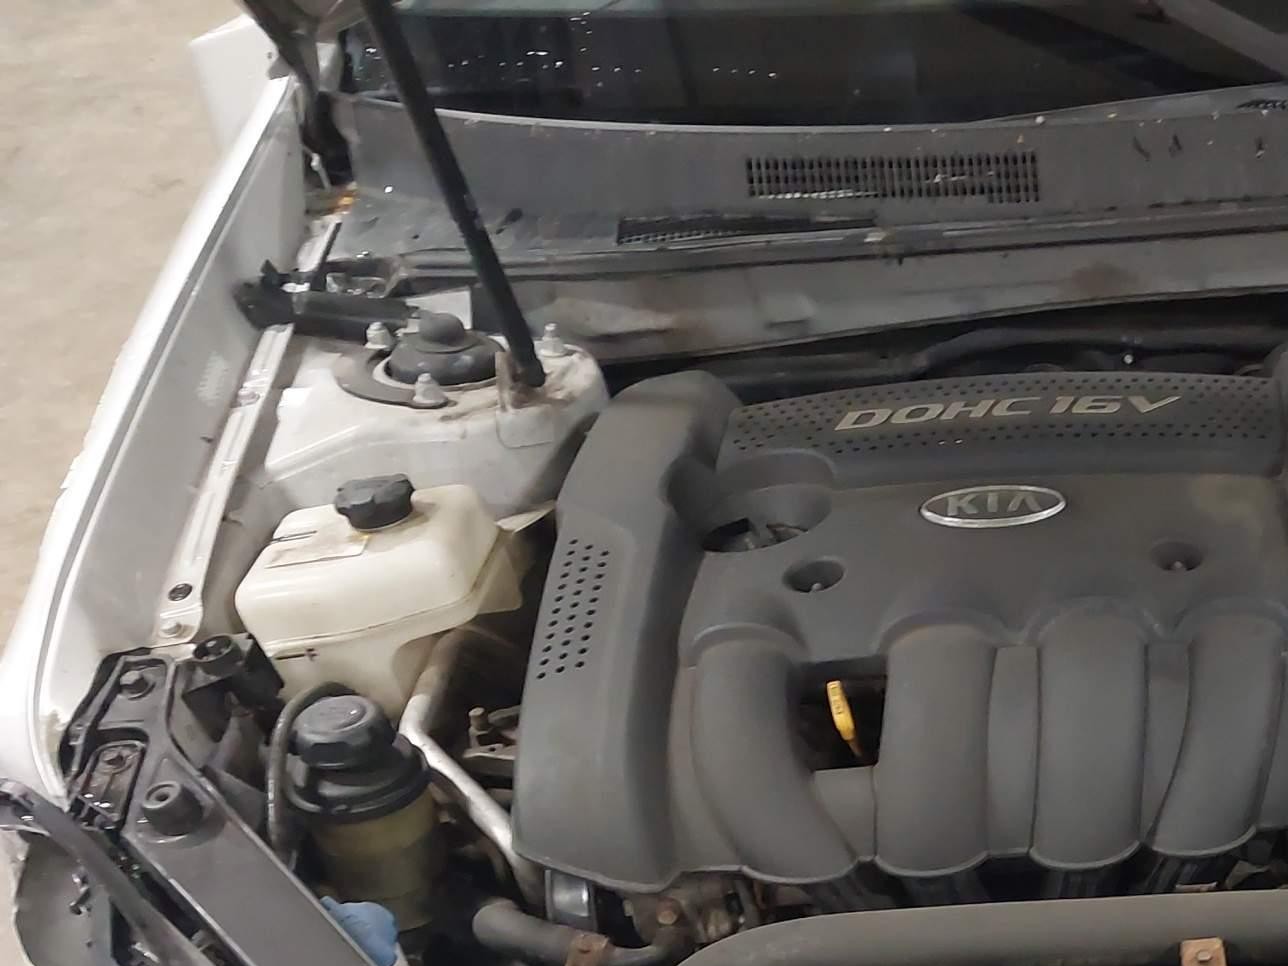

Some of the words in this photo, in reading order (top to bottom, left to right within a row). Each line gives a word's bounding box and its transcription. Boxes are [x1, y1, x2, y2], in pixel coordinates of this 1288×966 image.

[834, 396, 1042, 432] DOHC
[1049, 394, 1182, 416] 16V
[945, 492, 1042, 517] KIA
